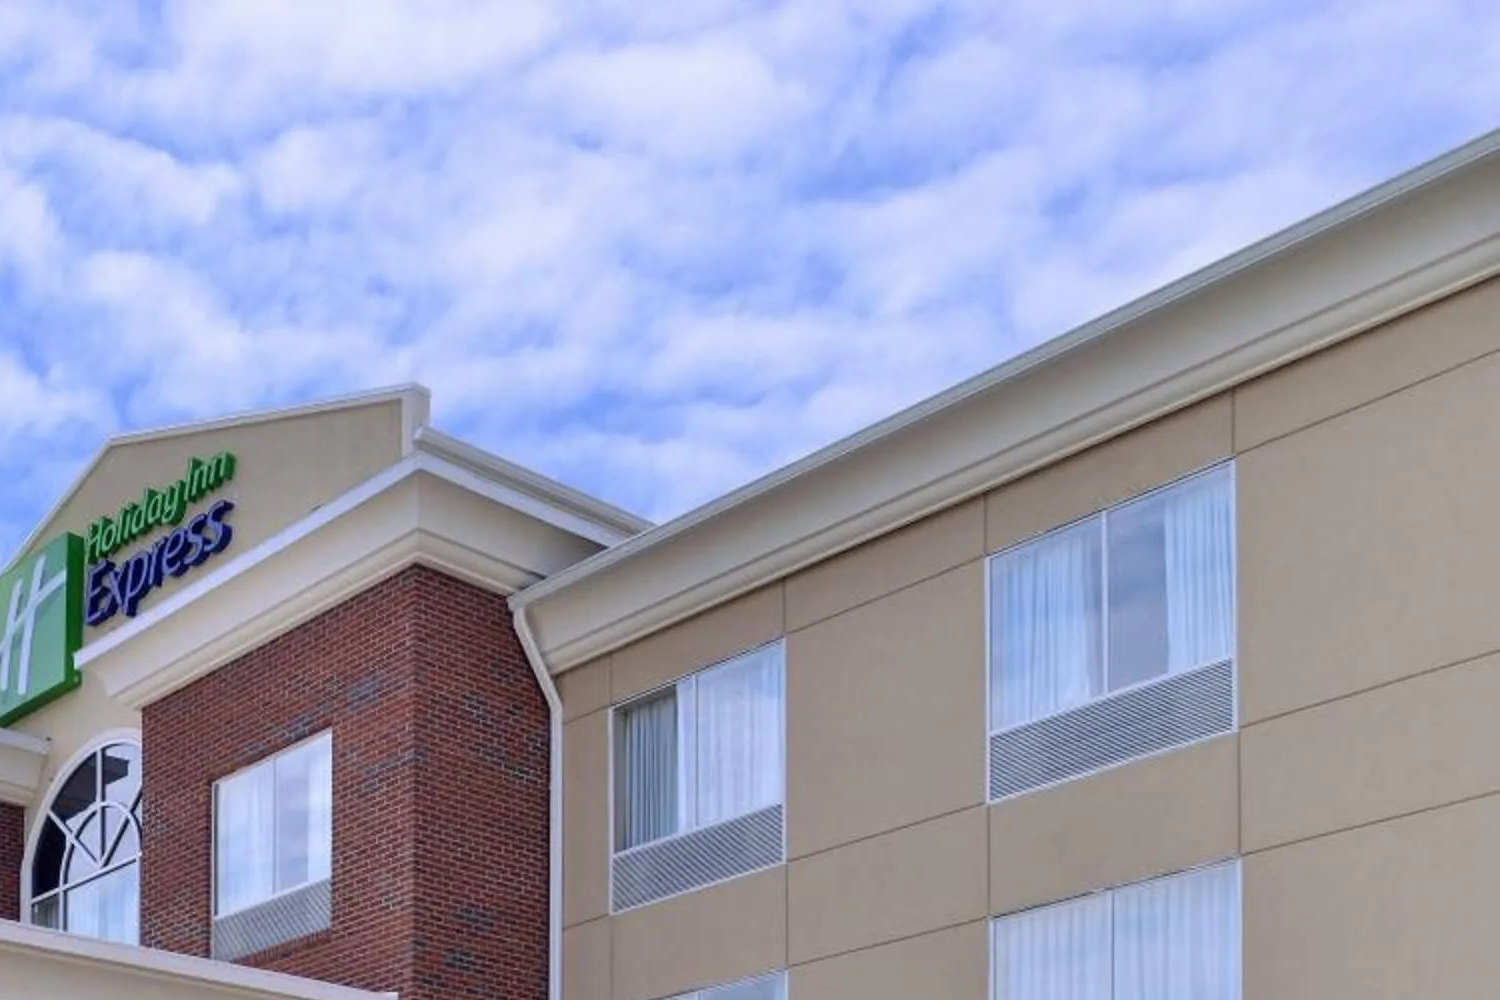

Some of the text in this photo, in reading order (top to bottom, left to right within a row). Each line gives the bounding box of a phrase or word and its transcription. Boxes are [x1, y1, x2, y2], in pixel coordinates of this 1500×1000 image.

[84, 451, 236, 566] Holiday Inn
[85, 500, 235, 627] Express
